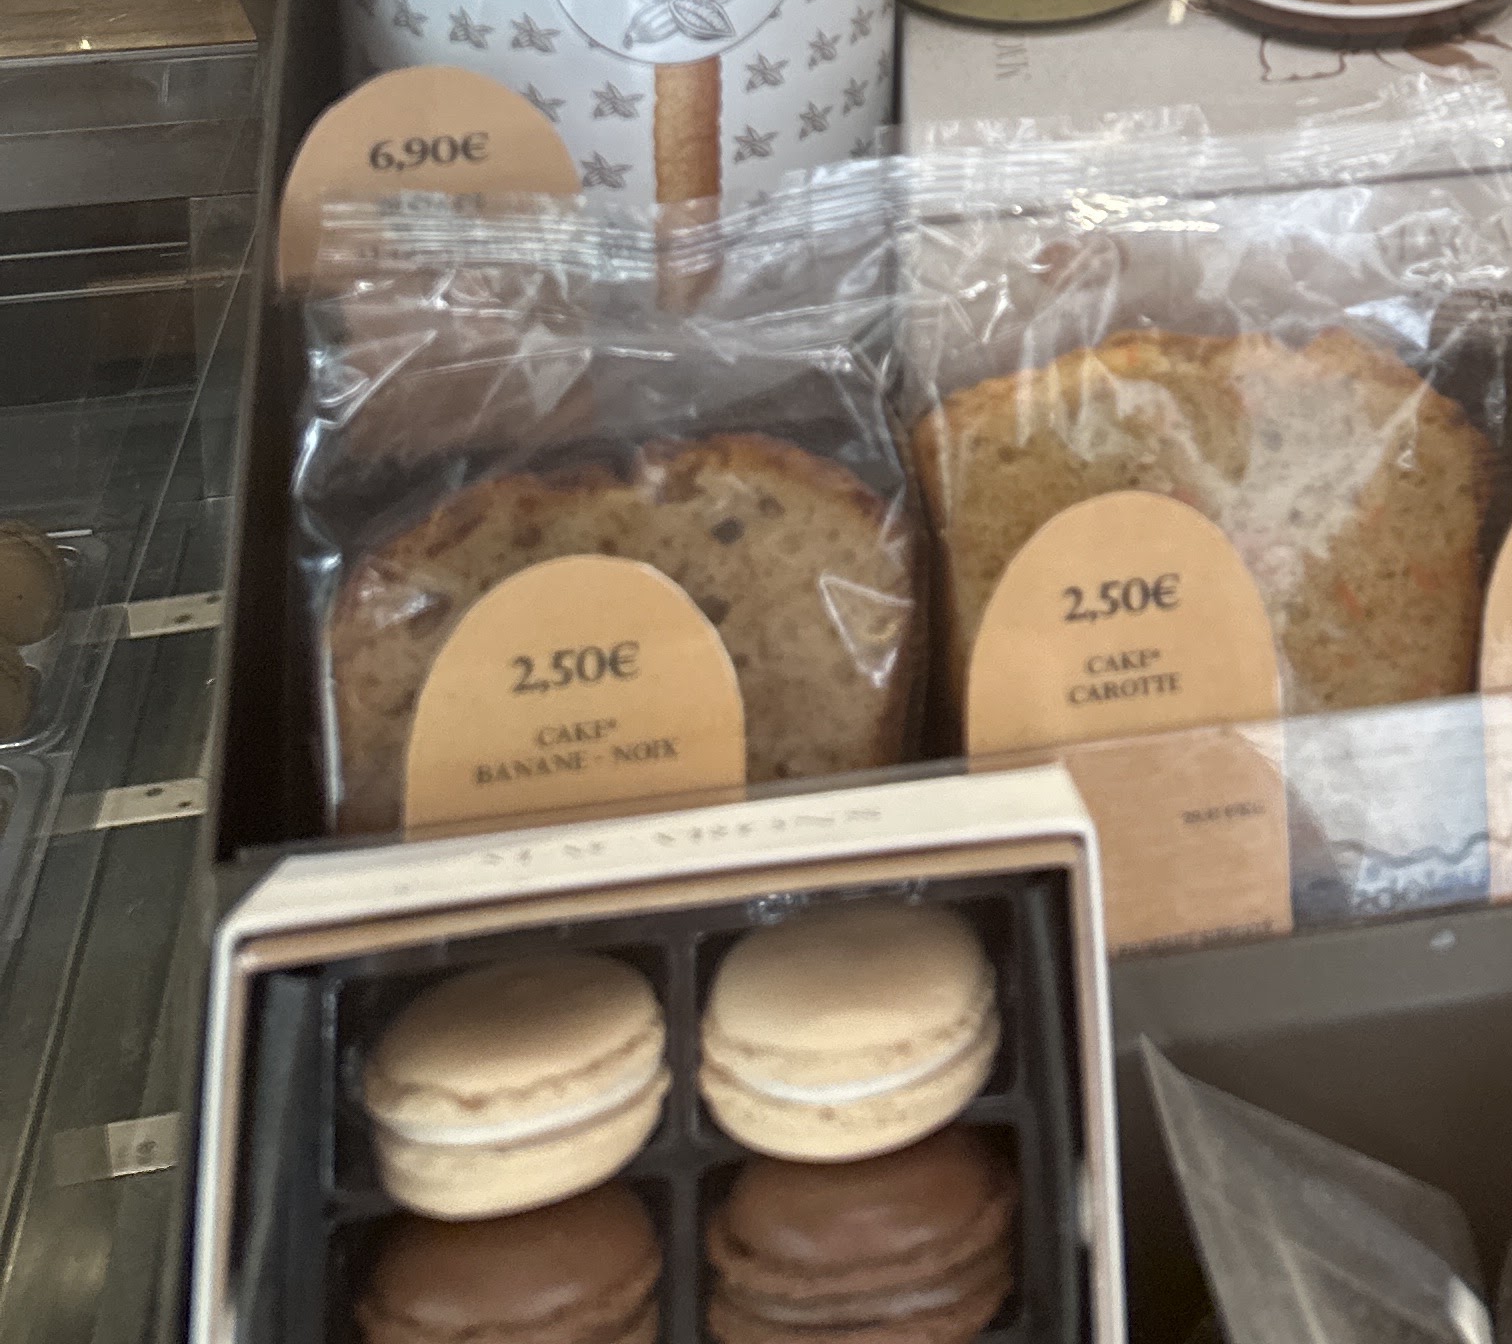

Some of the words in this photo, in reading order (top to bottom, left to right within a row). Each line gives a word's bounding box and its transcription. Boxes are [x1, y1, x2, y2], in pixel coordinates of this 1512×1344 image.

[369, 131, 489, 171] 6,90€
[1063, 572, 1181, 624] 2,50€
[510, 640, 641, 694] 2,50€
[1068, 672, 1181, 705] CAROTTE
[475, 751, 588, 785] BANANE
[612, 738, 680, 764] NOIX
